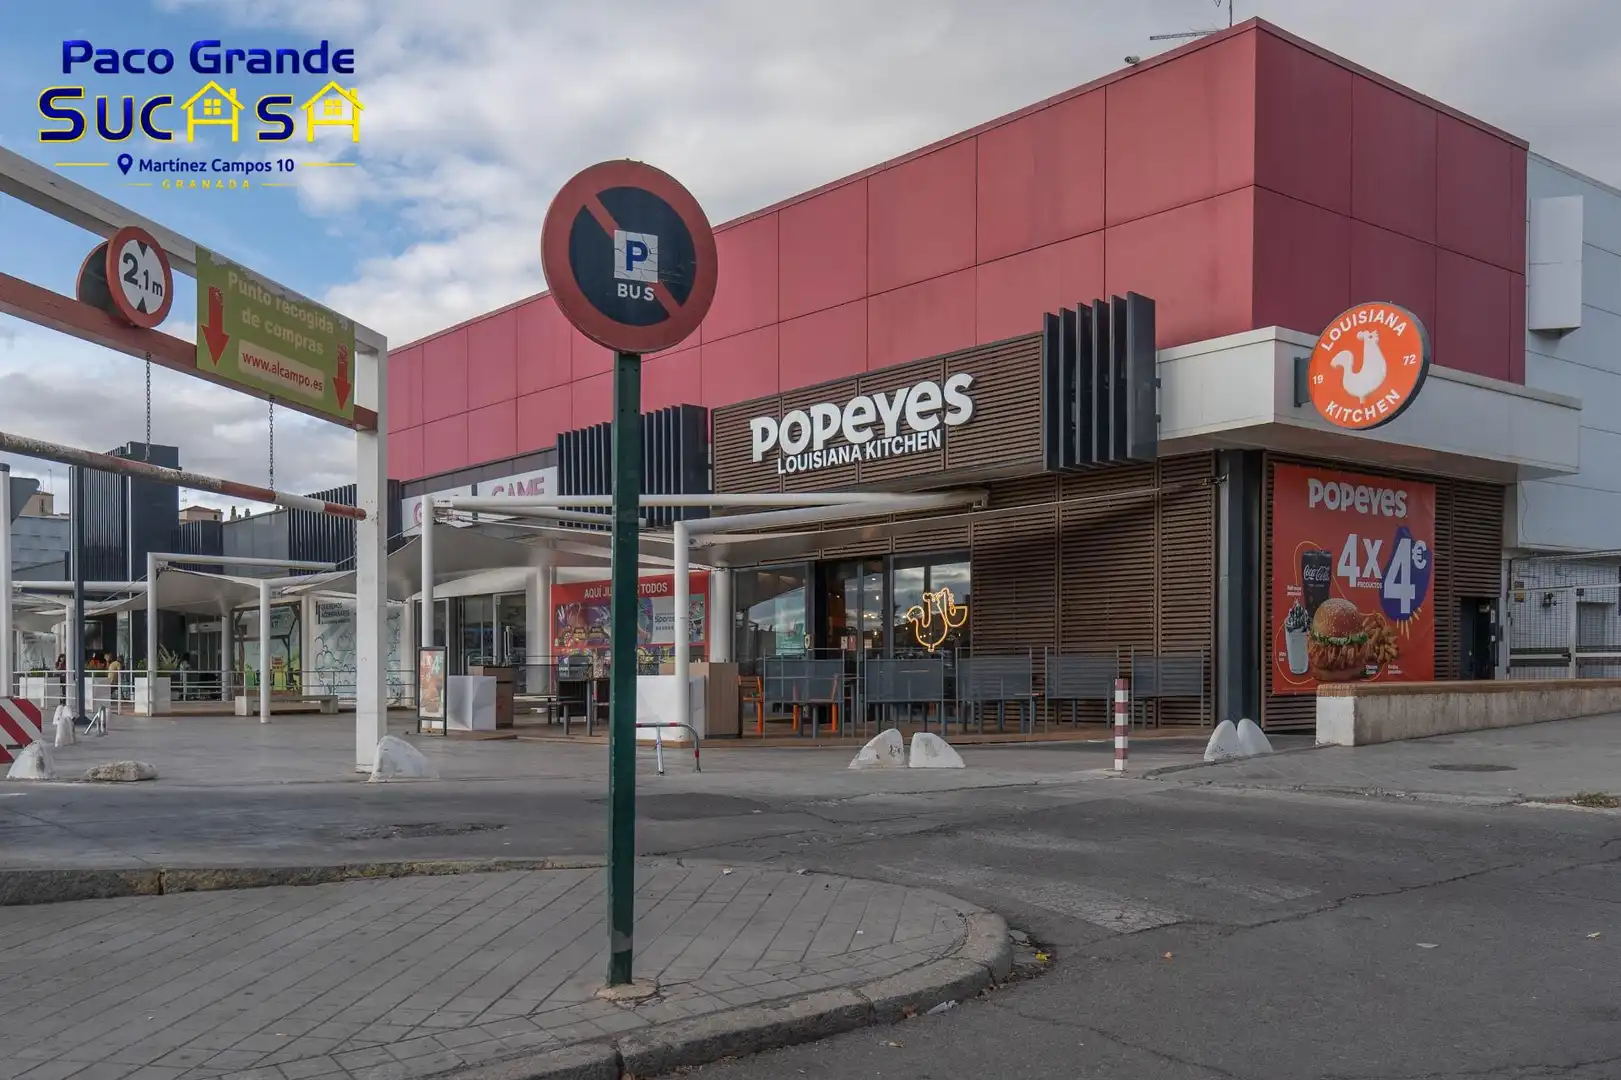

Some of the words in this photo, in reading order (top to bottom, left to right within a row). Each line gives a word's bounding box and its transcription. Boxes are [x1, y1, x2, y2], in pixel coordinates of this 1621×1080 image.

[626, 240, 648, 271] P
[228, 270, 271, 306] Punto
[275, 297, 334, 335] recogida
[618, 283, 654, 301] BUS
[242, 307, 260, 329] de
[264, 317, 324, 356] compras
[1321, 309, 1408, 351] LOUISIANA
[242, 351, 323, 392] www.alcampo.es
[1312, 374, 1324, 385] 19
[1403, 354, 1416, 365] 72
[1325, 389, 1400, 422] KITCHEN
[777, 444, 860, 475] LOUISIANA
[866, 429, 941, 460] KITCHEN
[584, 585, 602, 599] AQUÍ
[641, 582, 667, 594] TODOS
[1357, 581, 1382, 589] PRODUCTOS
